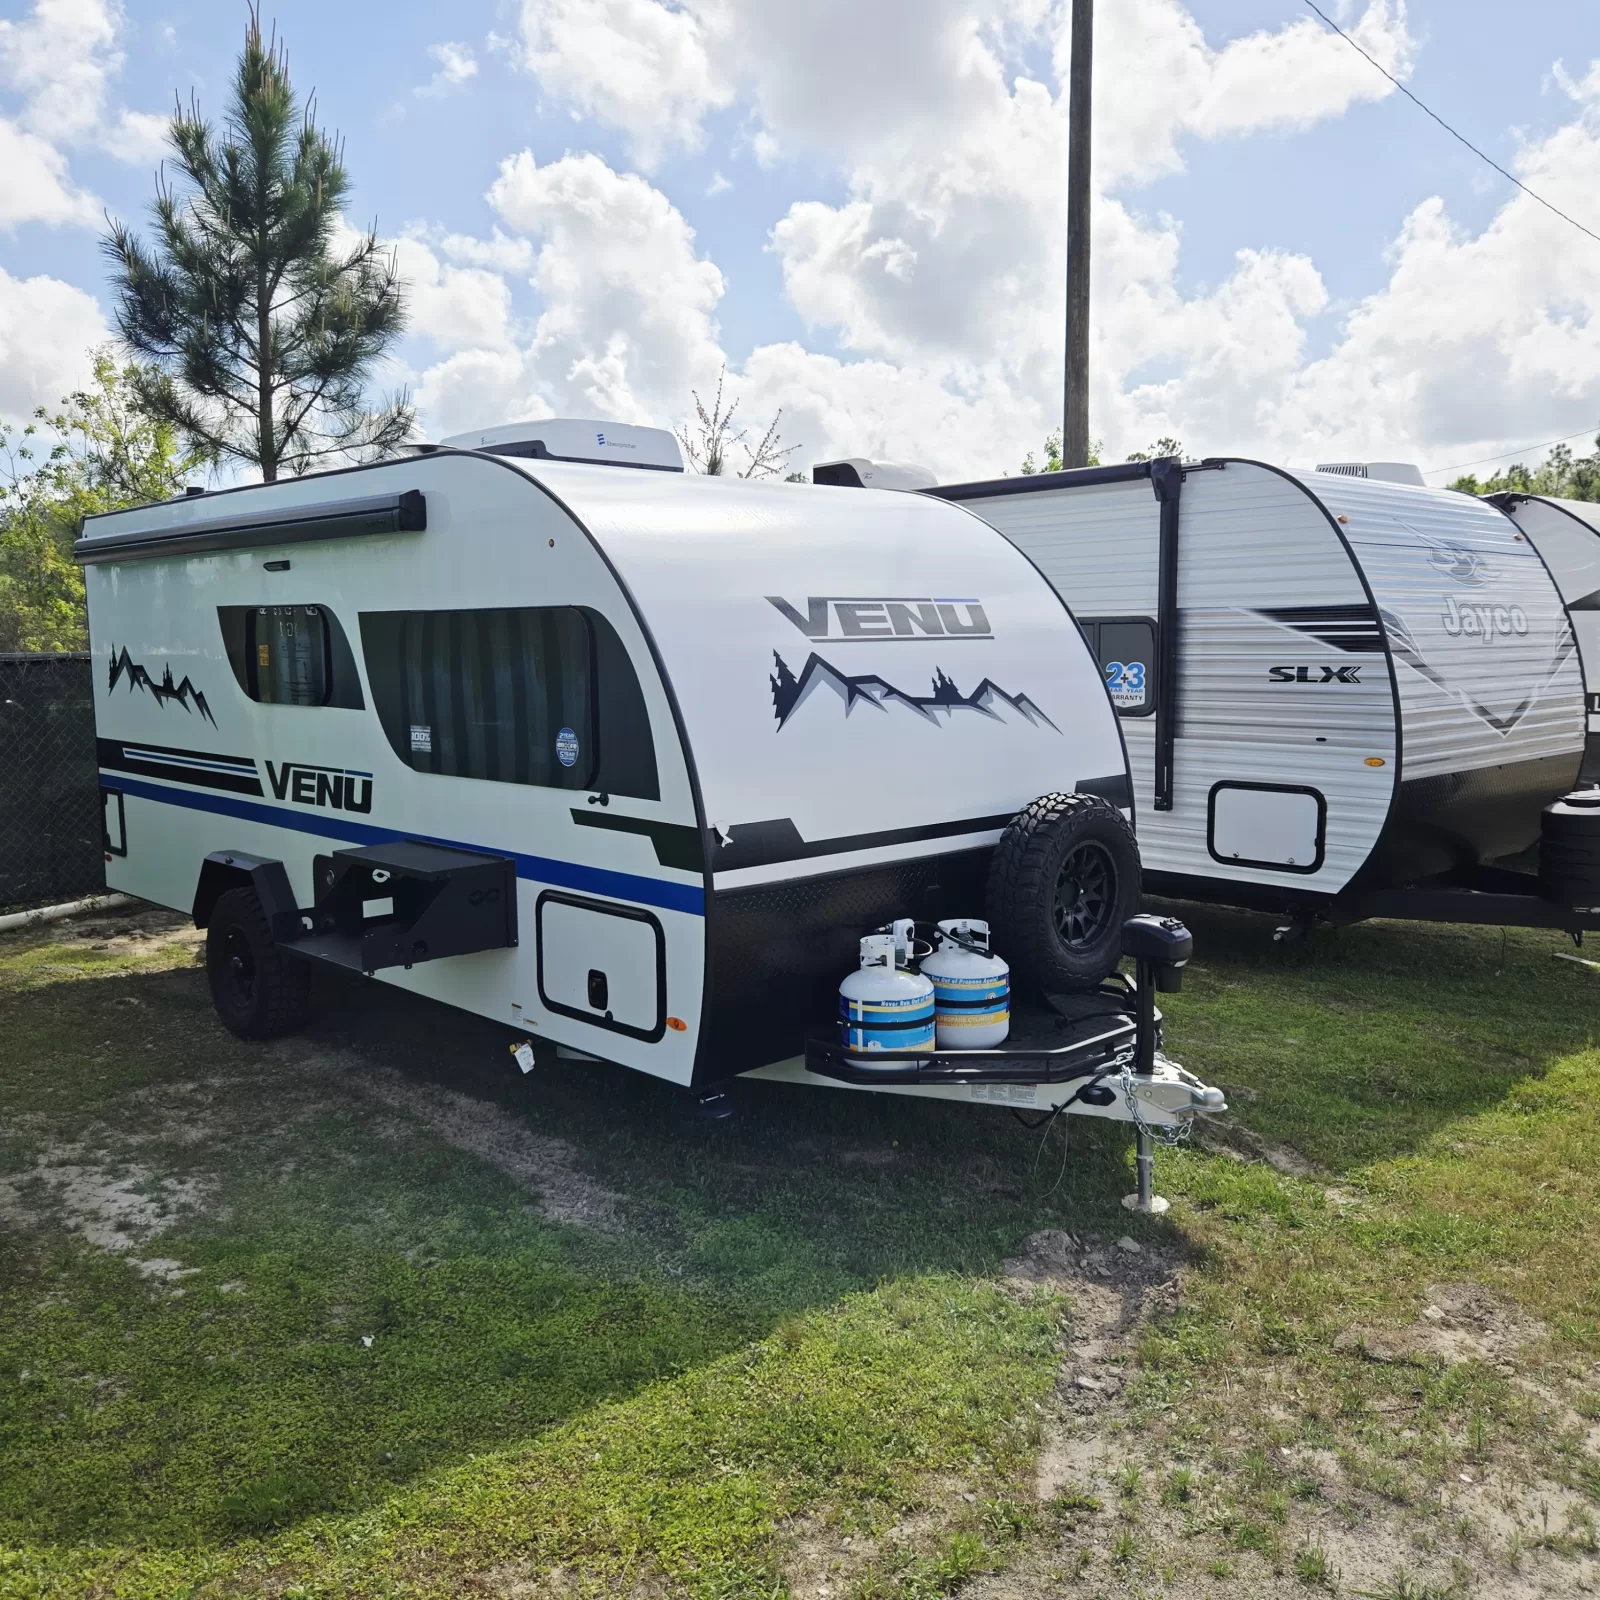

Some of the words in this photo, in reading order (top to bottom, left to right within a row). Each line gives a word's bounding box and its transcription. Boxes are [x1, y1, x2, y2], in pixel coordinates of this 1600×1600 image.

[763, 596, 992, 637] VENU
[1441, 594, 1529, 644] Jayco
[1269, 666, 1362, 683] SLX
[411, 731, 430, 742] 100%
[264, 760, 373, 814] VENU
[940, 1014, 966, 1022] PROPANE
